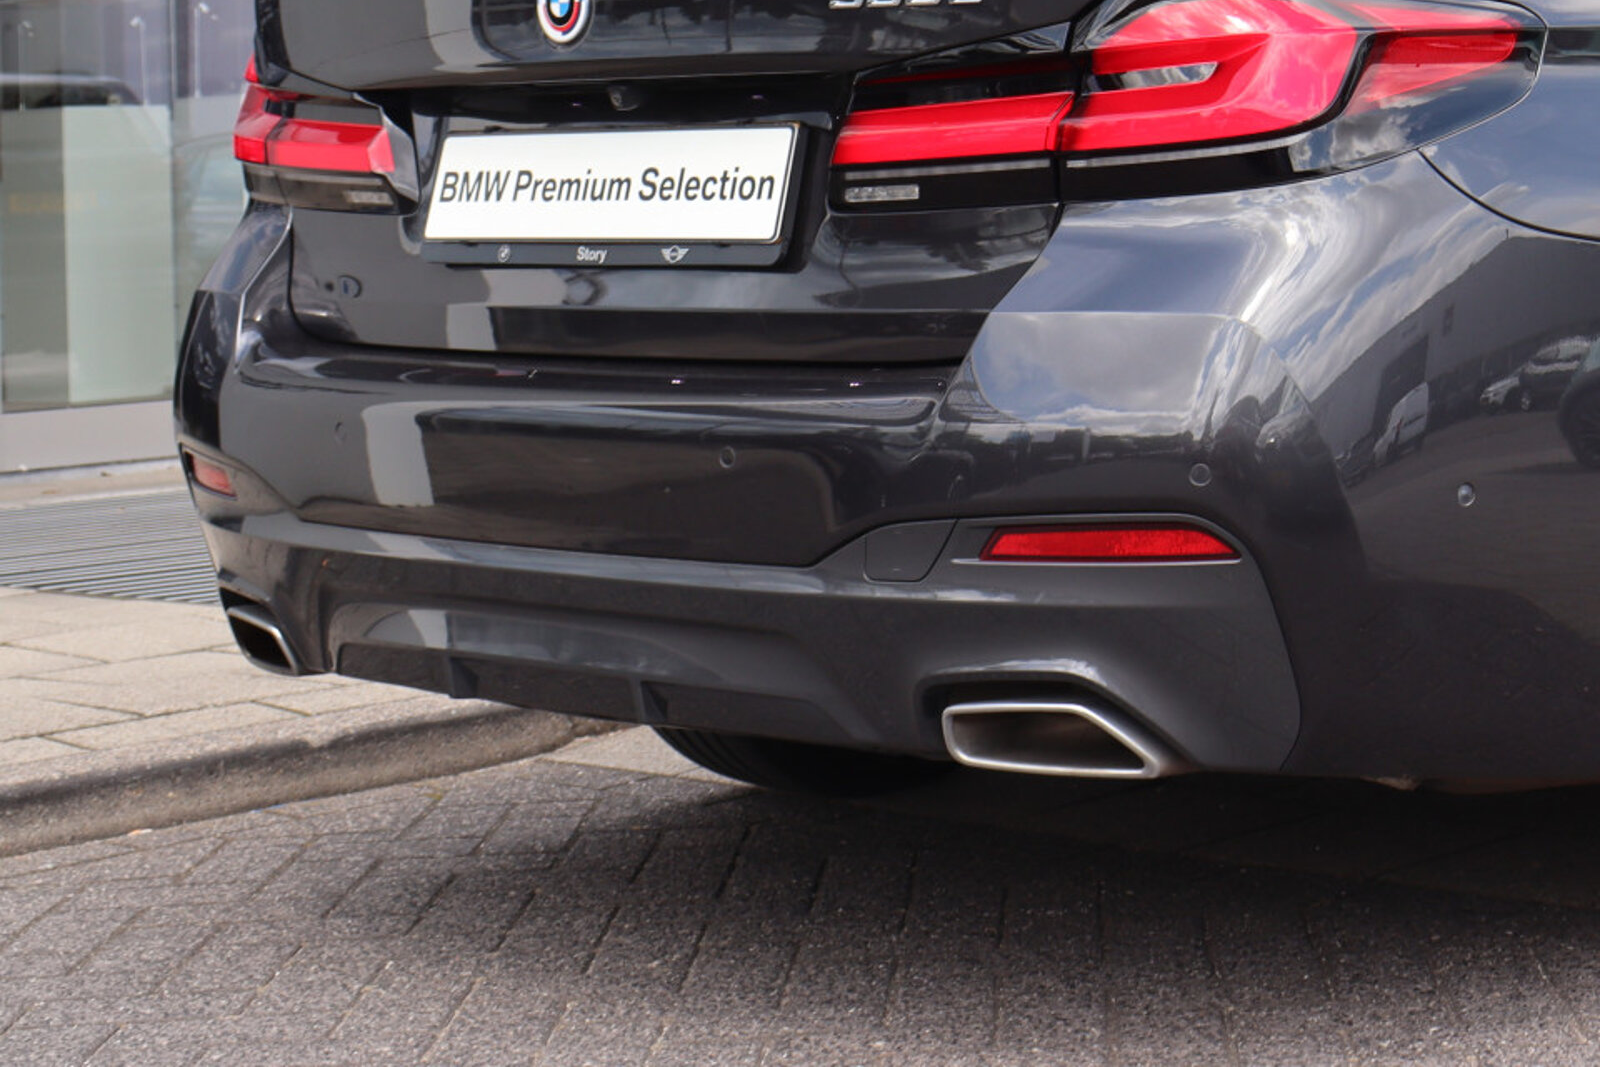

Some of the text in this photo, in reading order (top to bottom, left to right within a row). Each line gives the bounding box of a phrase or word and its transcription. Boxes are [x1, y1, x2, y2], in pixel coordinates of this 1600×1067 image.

[439, 166, 776, 203] BMW Premium Selection
[577, 245, 608, 264] Story
